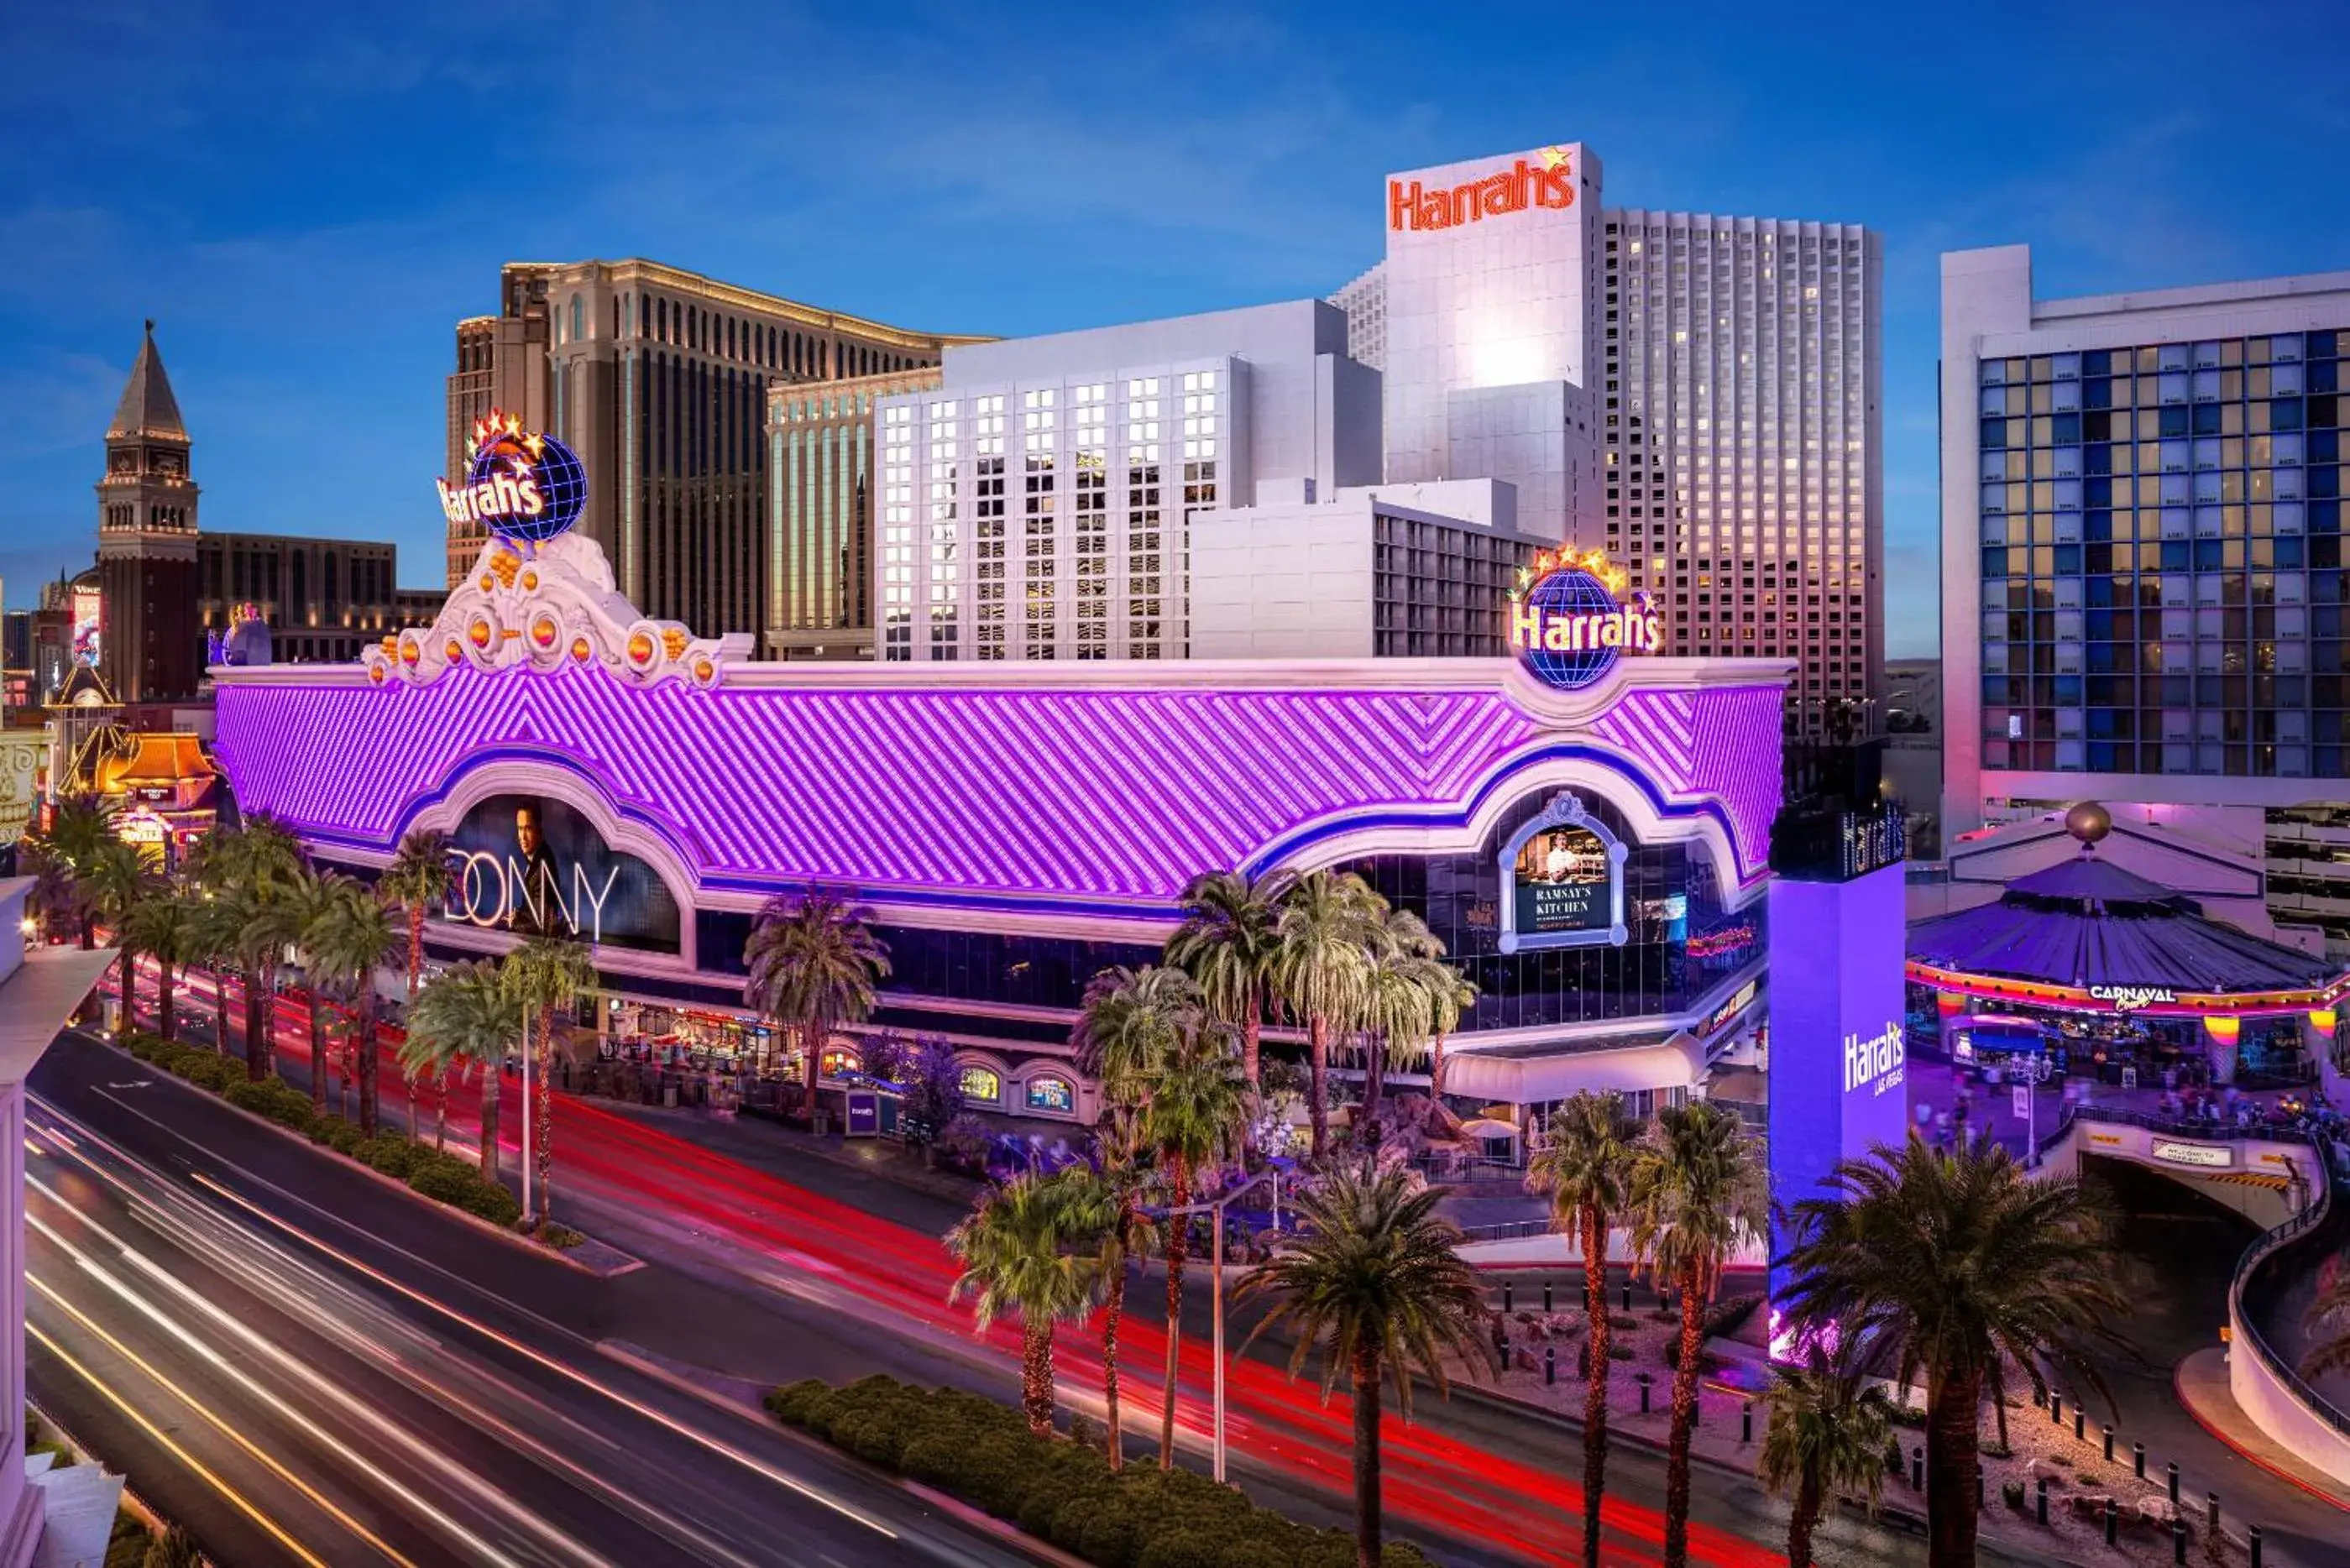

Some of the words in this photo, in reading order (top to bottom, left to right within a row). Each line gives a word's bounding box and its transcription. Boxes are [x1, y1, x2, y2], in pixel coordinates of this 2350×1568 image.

[445, 848, 620, 945] DONNY
[1536, 886, 1592, 901] RAMSAY'S
[1536, 901, 1588, 915] KITCHEN
[2091, 986, 2177, 1001] CARNAVAL
